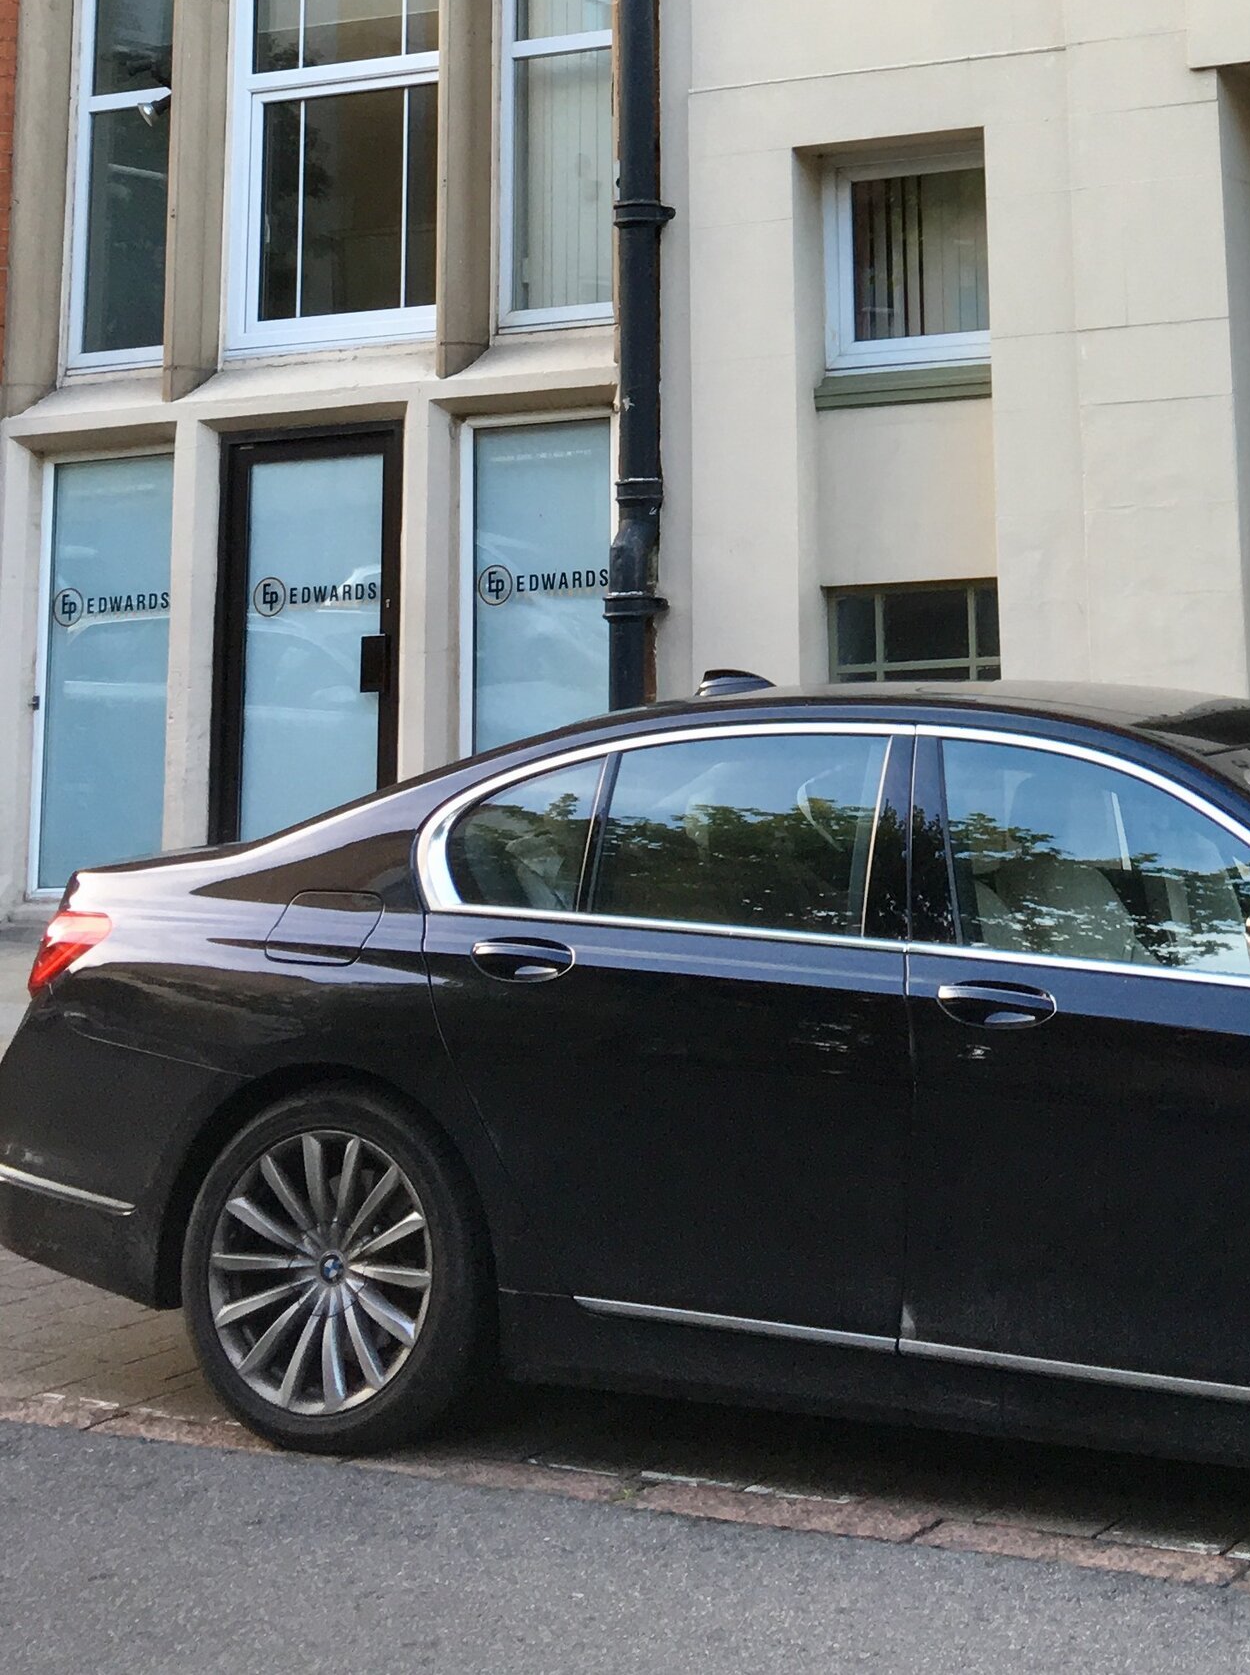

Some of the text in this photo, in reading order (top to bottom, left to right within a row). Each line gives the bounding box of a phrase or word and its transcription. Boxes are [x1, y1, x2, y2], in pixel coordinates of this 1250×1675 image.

[516, 568, 609, 593] EDWARDS
[86, 591, 170, 614] EDWARDS
[289, 582, 377, 605] EDWARDS
